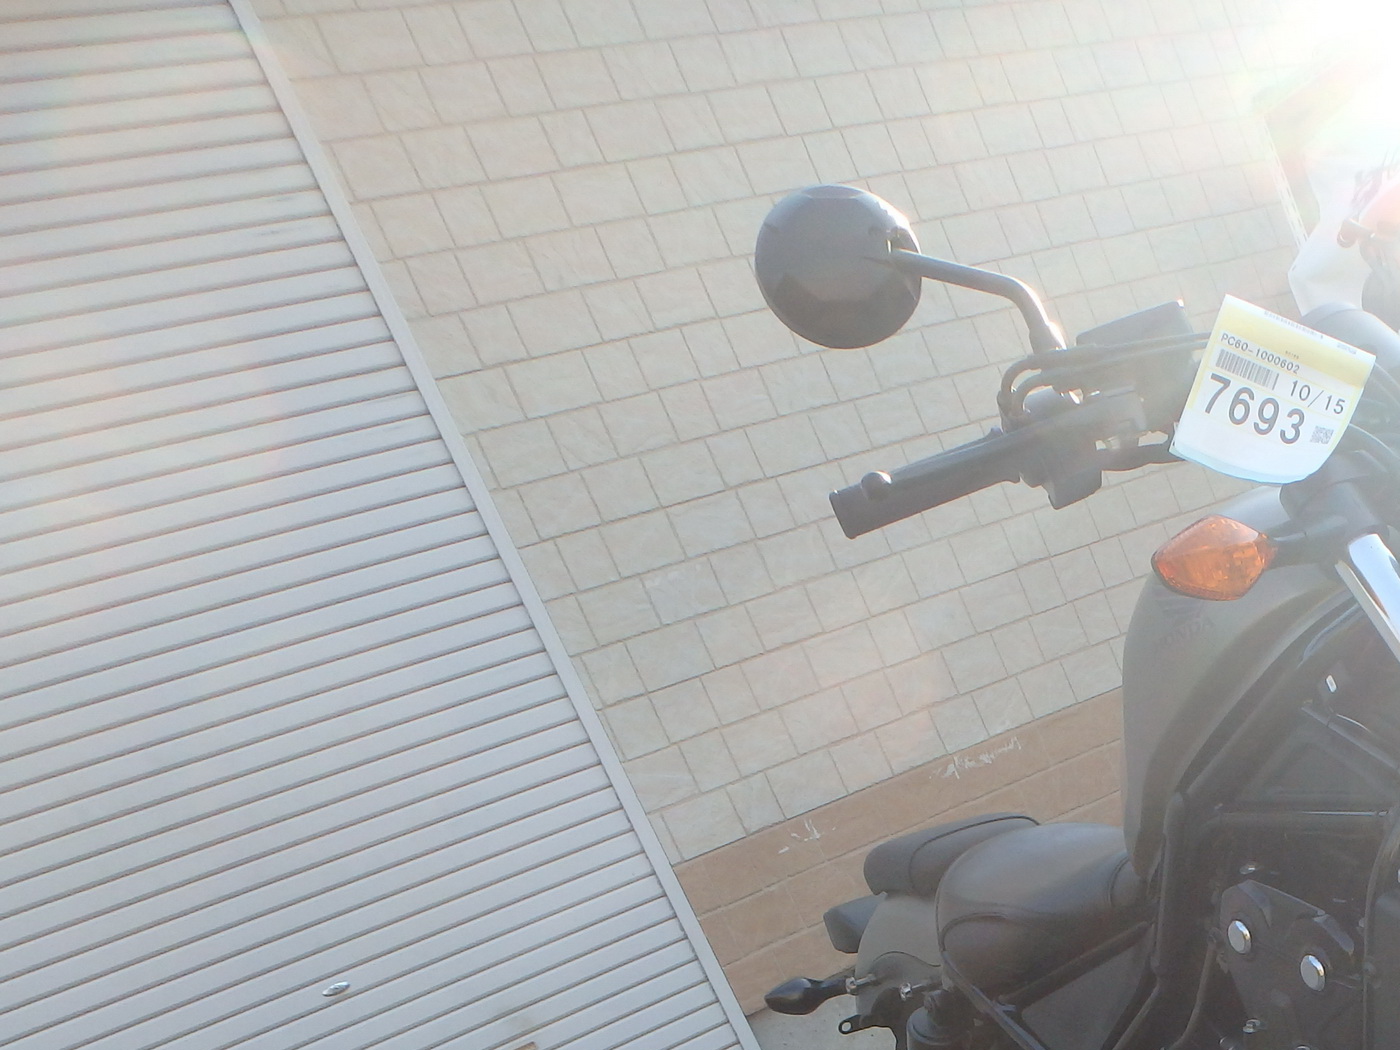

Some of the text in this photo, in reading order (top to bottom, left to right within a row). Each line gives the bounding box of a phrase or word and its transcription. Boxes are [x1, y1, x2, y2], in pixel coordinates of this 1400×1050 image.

[1220, 333, 1301, 374] PC60-1000602
[1204, 373, 1306, 445] 7693
[1290, 379, 1346, 415] 10/15
